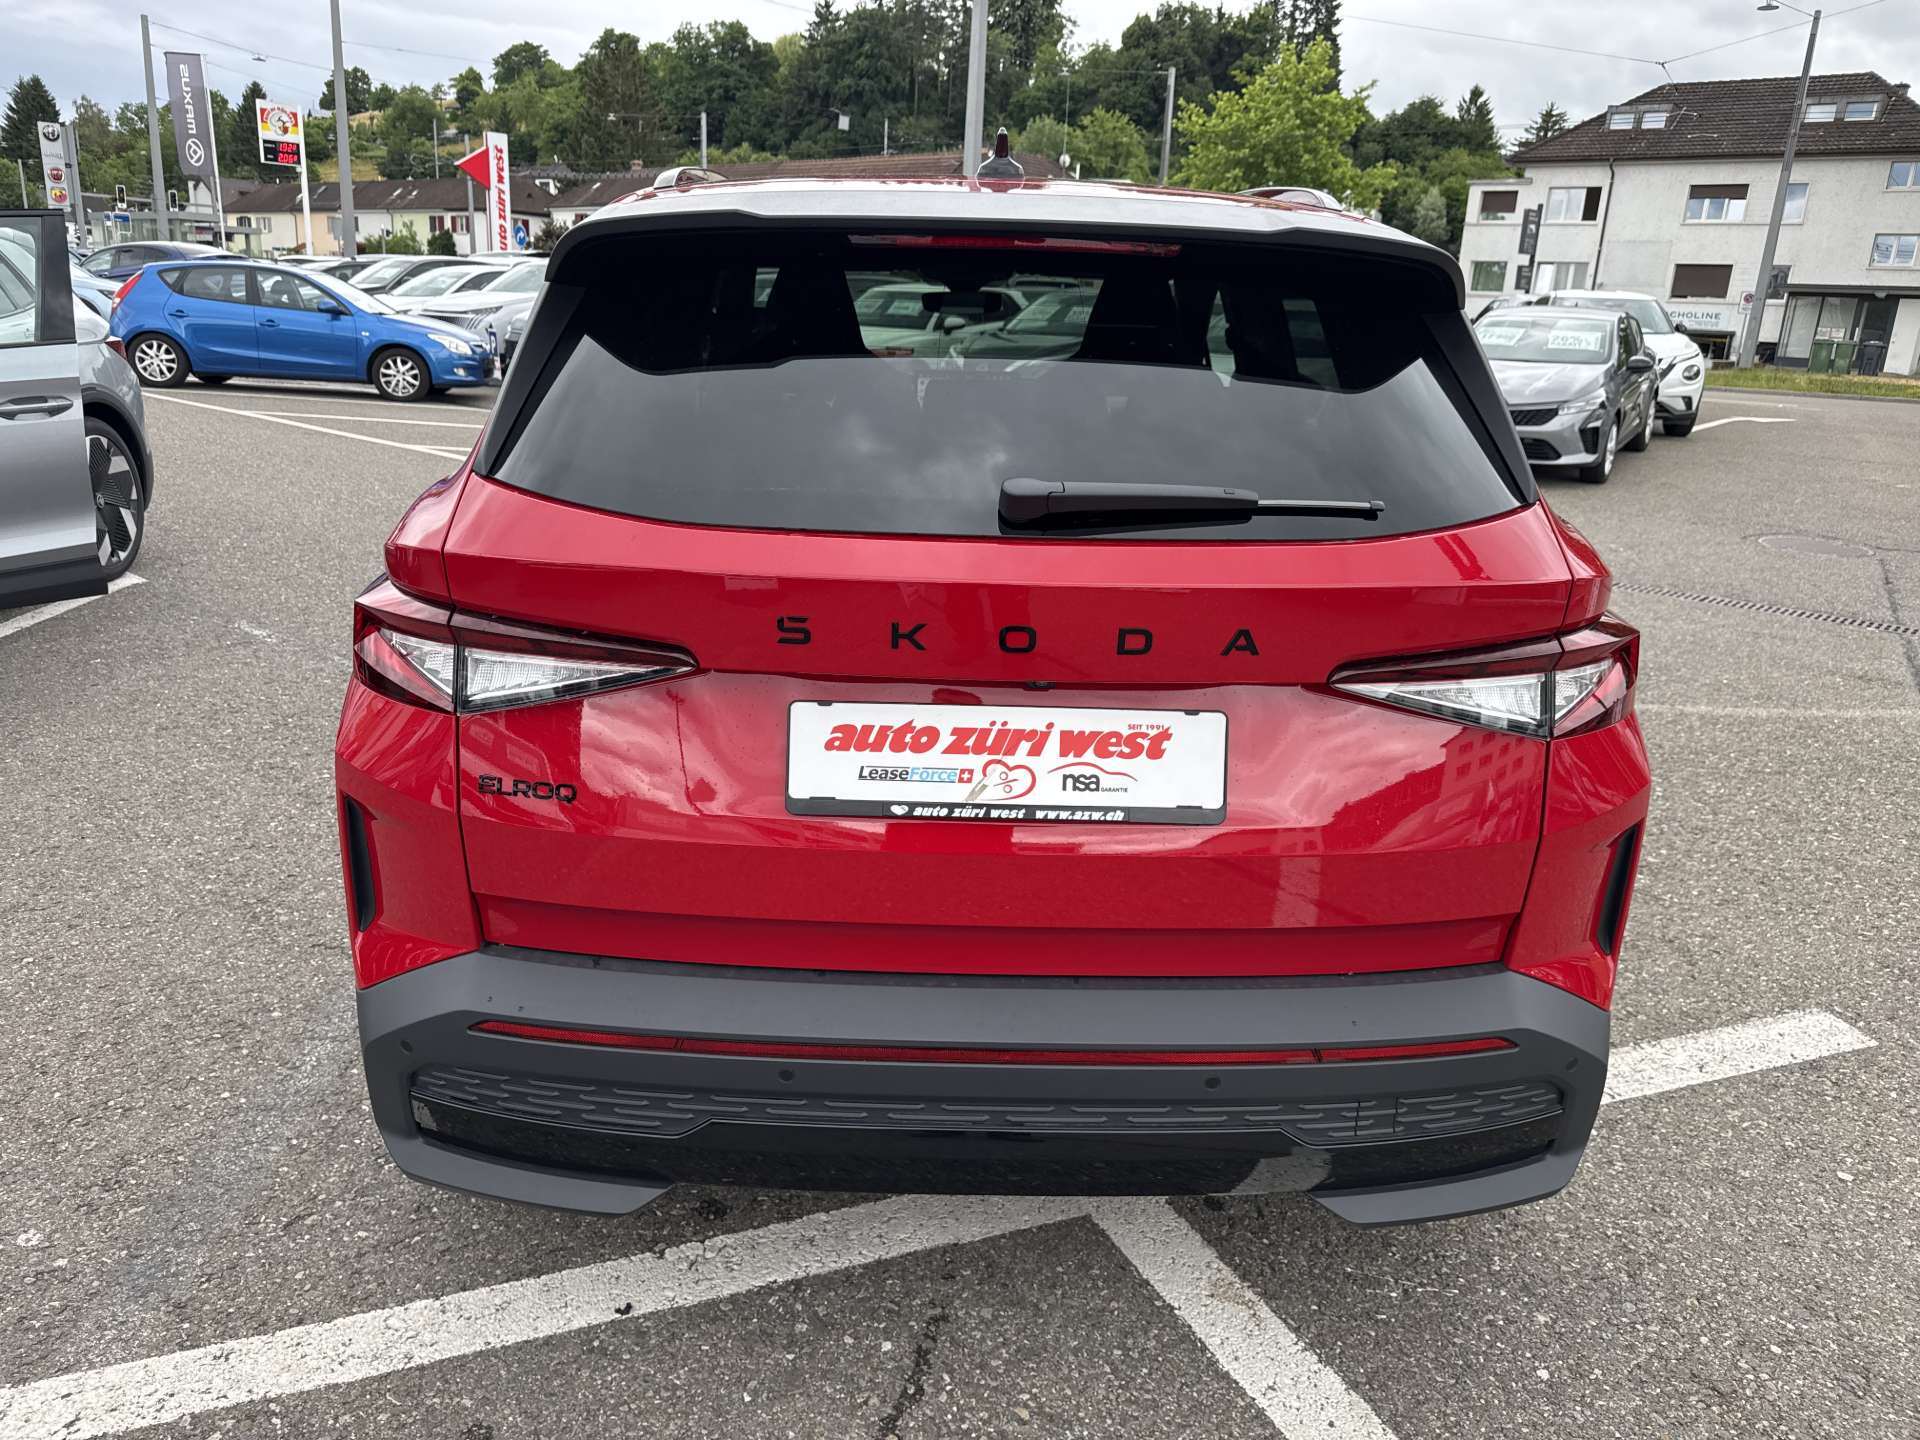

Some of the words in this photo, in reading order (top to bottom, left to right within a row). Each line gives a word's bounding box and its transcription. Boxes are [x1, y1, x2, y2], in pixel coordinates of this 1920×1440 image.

[494, 144, 505, 184] west
[498, 223, 508, 251] uto
[1127, 723, 1143, 731] SEIT
[824, 719, 941, 754] auto
[941, 720, 1055, 757] züri
[1059, 726, 1174, 760] west
[858, 765, 959, 783] LeaseForce
[1062, 773, 1100, 792] nsa
[478, 774, 577, 804] ELROQ
[912, 805, 949, 817] auto
[952, 804, 986, 818] züri
[990, 806, 1026, 819] west
[1035, 808, 1125, 821] www.azw.ch
